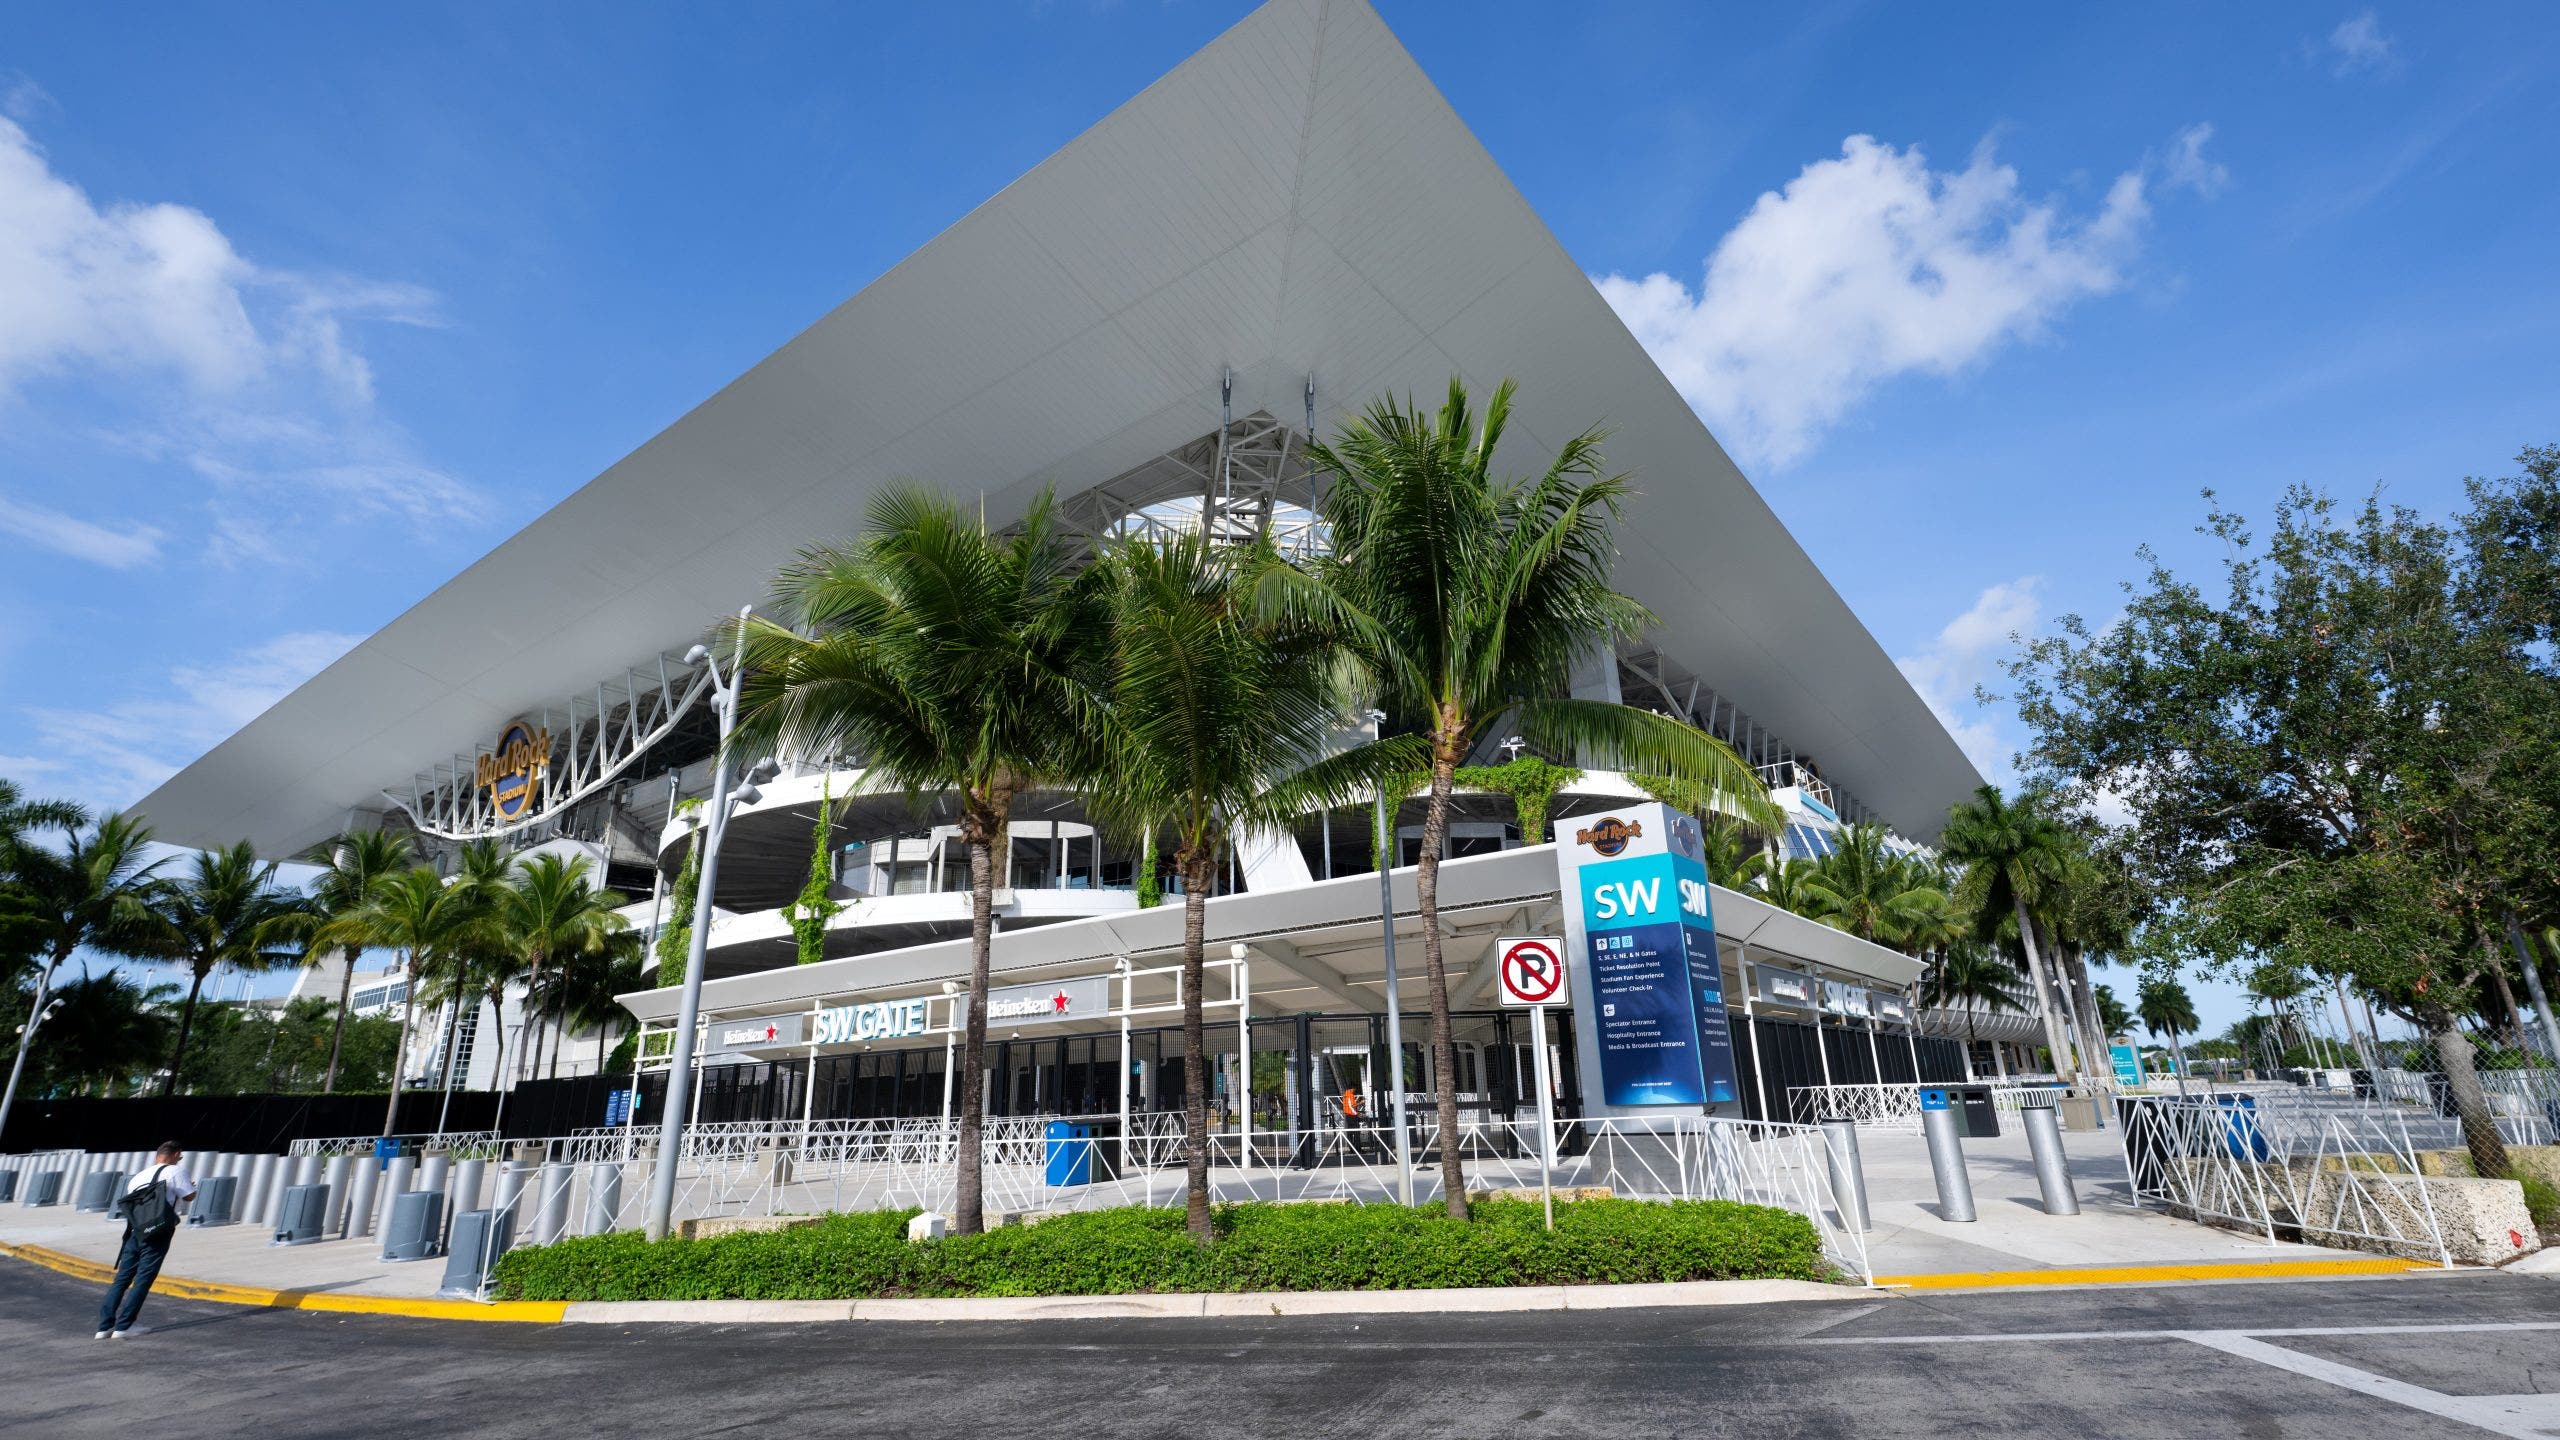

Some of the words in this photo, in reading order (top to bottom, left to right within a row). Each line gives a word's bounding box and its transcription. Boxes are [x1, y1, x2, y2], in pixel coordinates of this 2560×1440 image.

[475, 742, 511, 789] Hard
[511, 727, 551, 777] Rock
[499, 783, 527, 803] STADIUM
[1576, 826, 1609, 845] Hard
[1610, 819, 1642, 838] Rock
[1594, 877, 1660, 919] SW
[1680, 878, 1707, 917] SW
[1635, 973, 1665, 981] Experience
[986, 996, 1052, 1017] Heineken
[816, 1008, 856, 1044] SW
[856, 999, 924, 1040] GATE
[723, 1025, 766, 1045] Heineken
